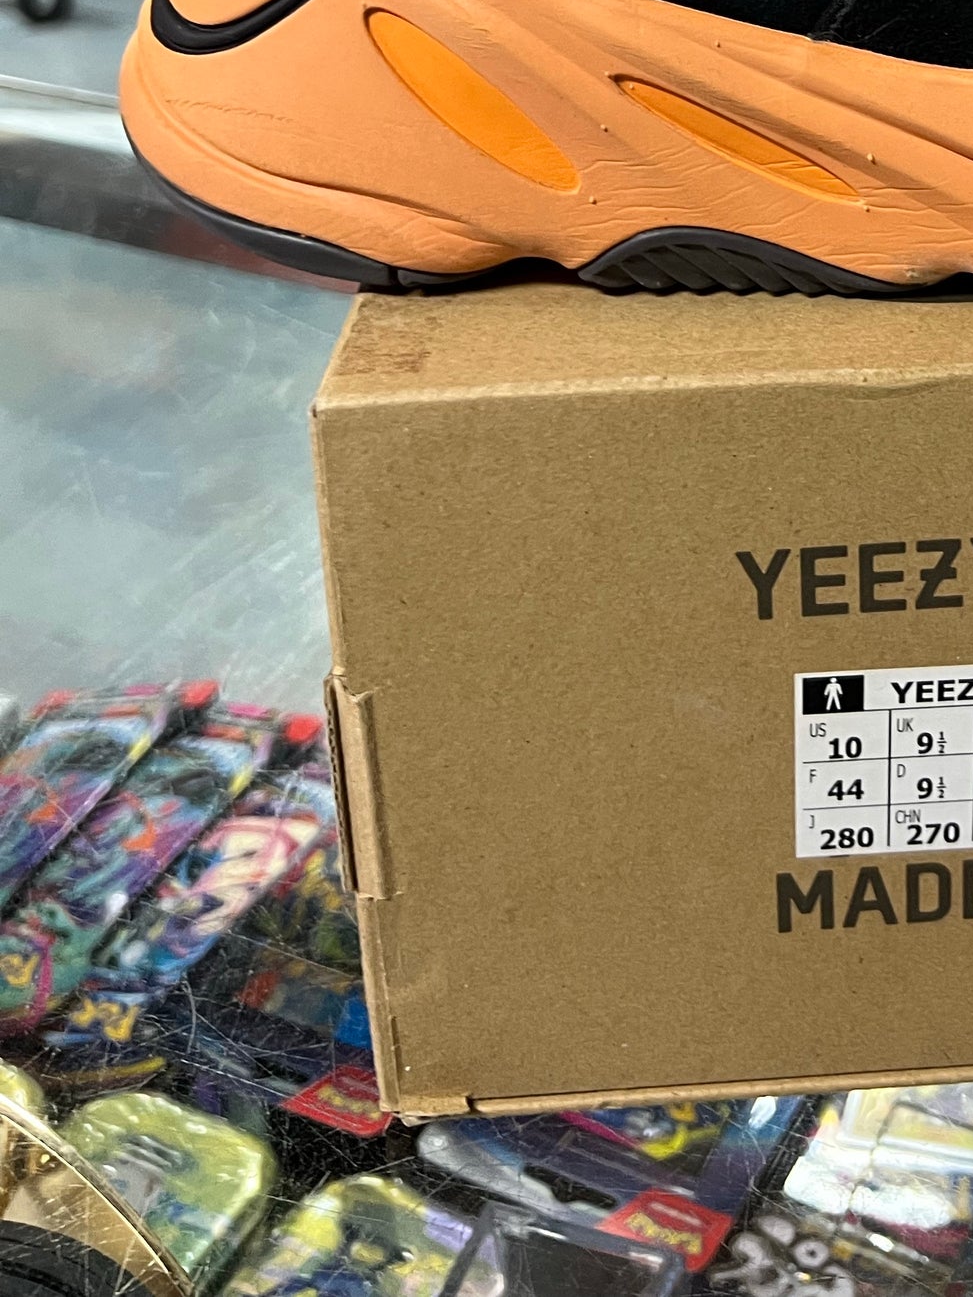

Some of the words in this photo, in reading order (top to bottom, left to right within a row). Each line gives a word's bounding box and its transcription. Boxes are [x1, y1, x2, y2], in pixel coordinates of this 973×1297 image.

[896, 717, 914, 733] UK
[809, 722, 827, 738] US
[828, 736, 863, 760] 10
[896, 763, 906, 778] D
[809, 768, 817, 784] F
[827, 778, 865, 801] 44
[895, 809, 922, 824] CHN
[808, 814, 816, 829] J
[820, 826, 874, 850] 280
[906, 821, 961, 845] 270
